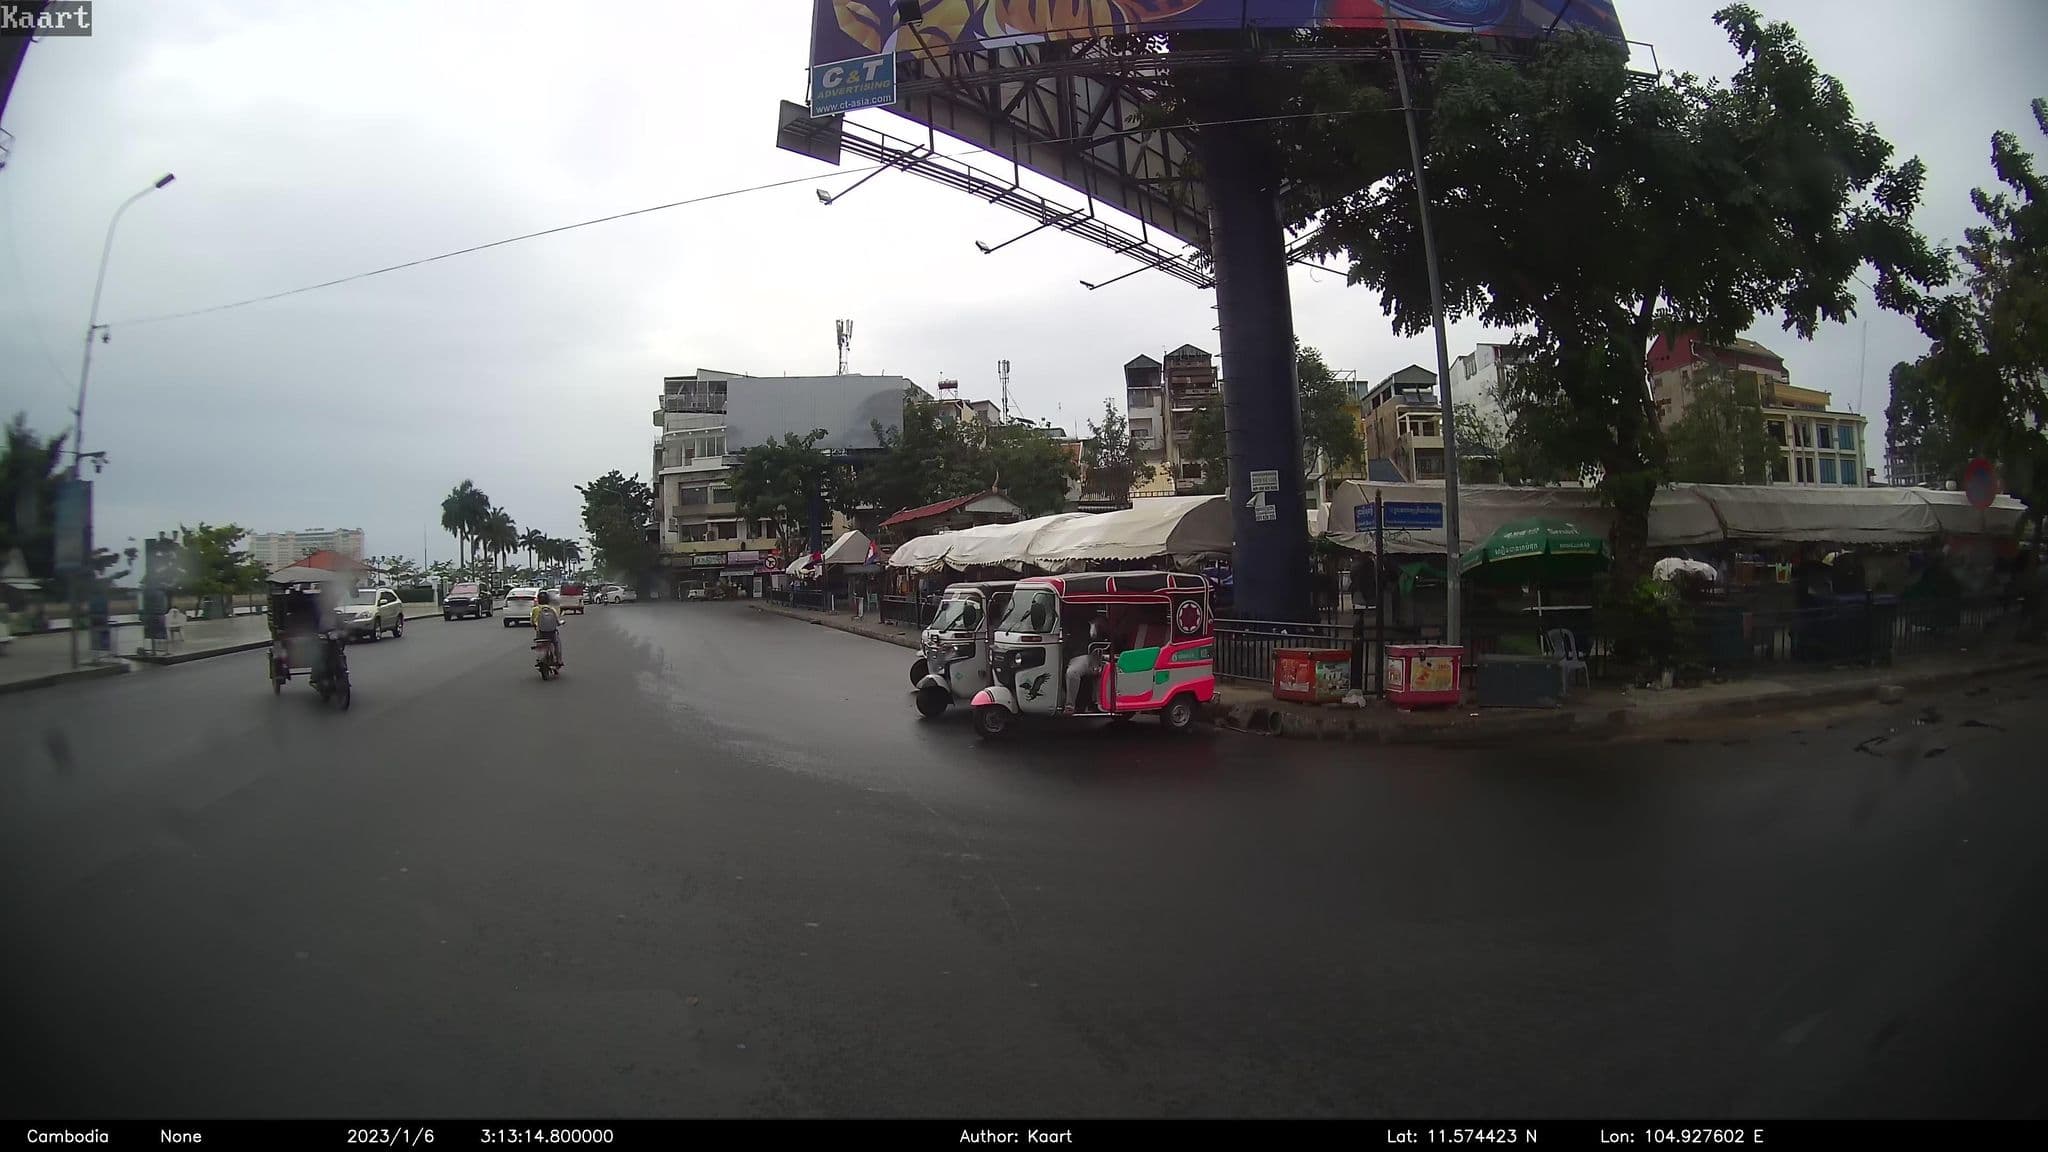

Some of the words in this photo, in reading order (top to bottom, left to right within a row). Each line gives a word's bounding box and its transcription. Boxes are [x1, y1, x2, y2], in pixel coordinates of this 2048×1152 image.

[822, 66, 844, 88] C
[846, 70, 860, 83] &
[863, 59, 884, 82] T
[817, 79, 891, 99] ADVERTISING
[815, 95, 892, 114] www.ct-asia.com
